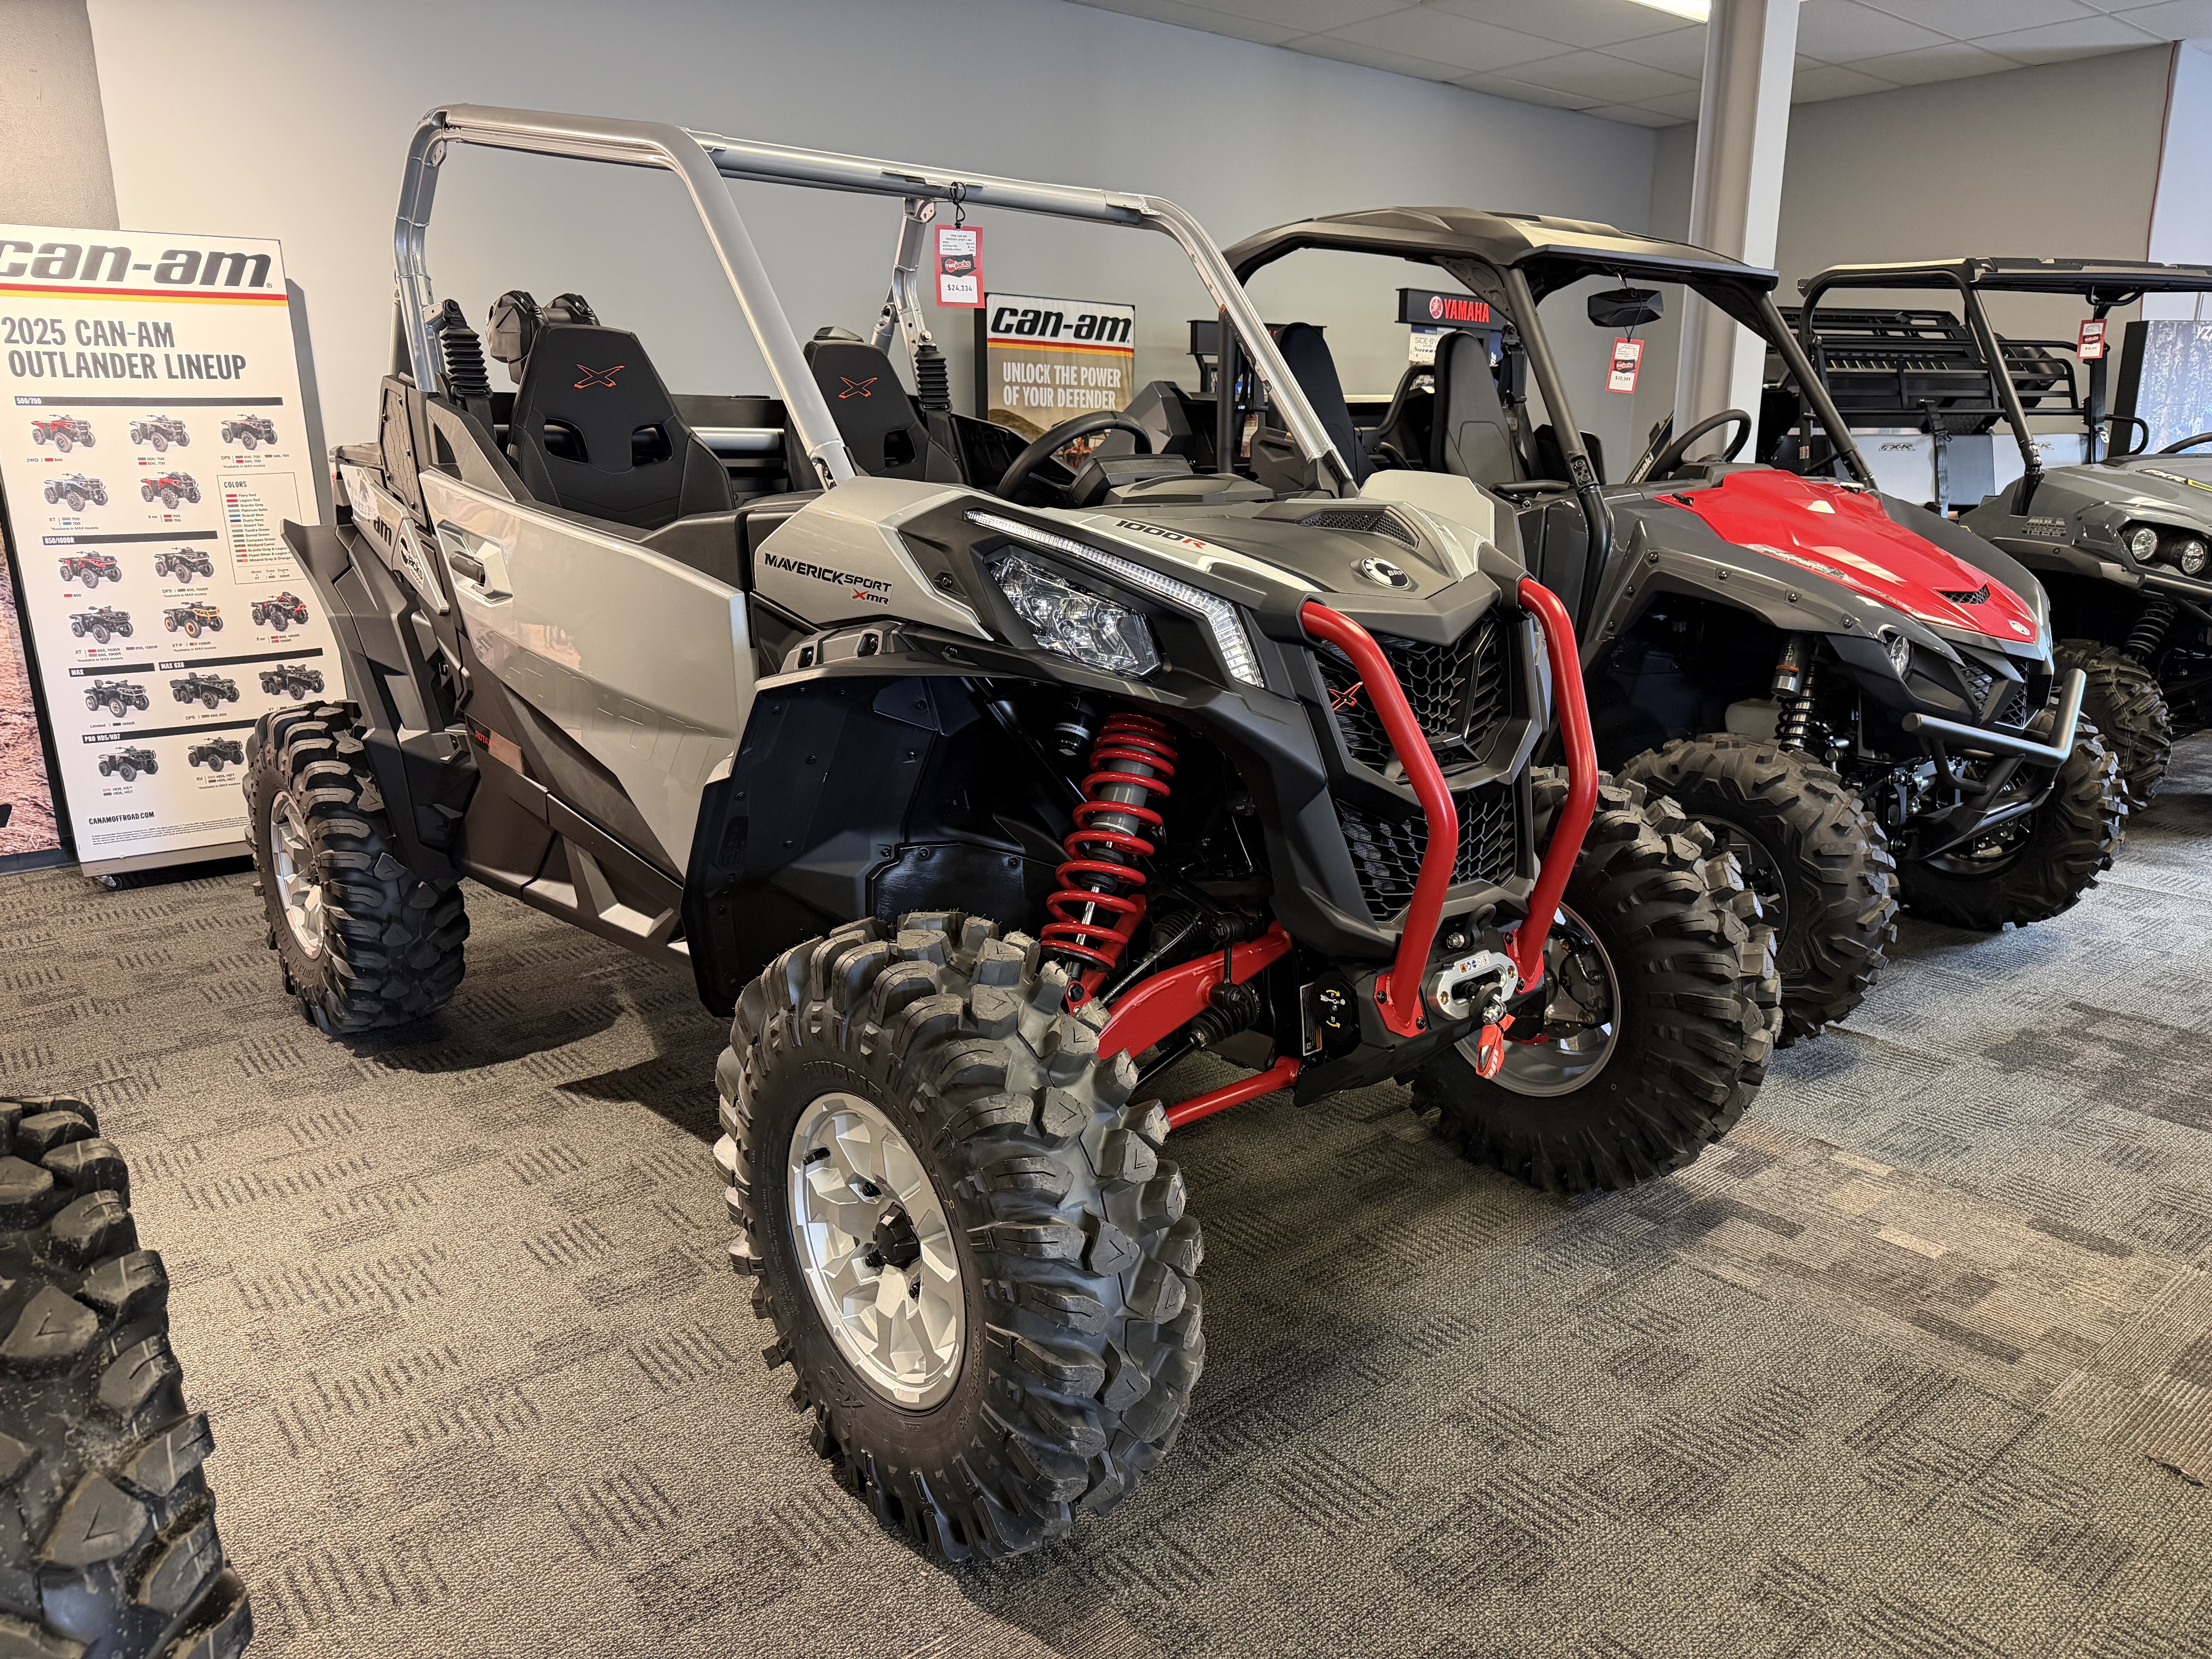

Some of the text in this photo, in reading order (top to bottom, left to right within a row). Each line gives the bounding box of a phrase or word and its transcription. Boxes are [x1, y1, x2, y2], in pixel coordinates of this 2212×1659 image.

[955, 261, 971, 270] jacks
[1444, 298, 1490, 323] YAMAHA
[1, 317, 175, 347] 2025 CAN-AM
[991, 307, 1132, 343] can-am
[9, 350, 247, 380] OUTLANDER LINEUP
[1003, 362, 1121, 388] UNLOCK THE POWER
[1003, 385, 1116, 409] OF YOUR DEFENDER
[1115, 519, 1206, 549] 1000R
[764, 552, 892, 592] MAVERICK SPORT
[89, 811, 155, 824] CANAMOFFROAD.COM
